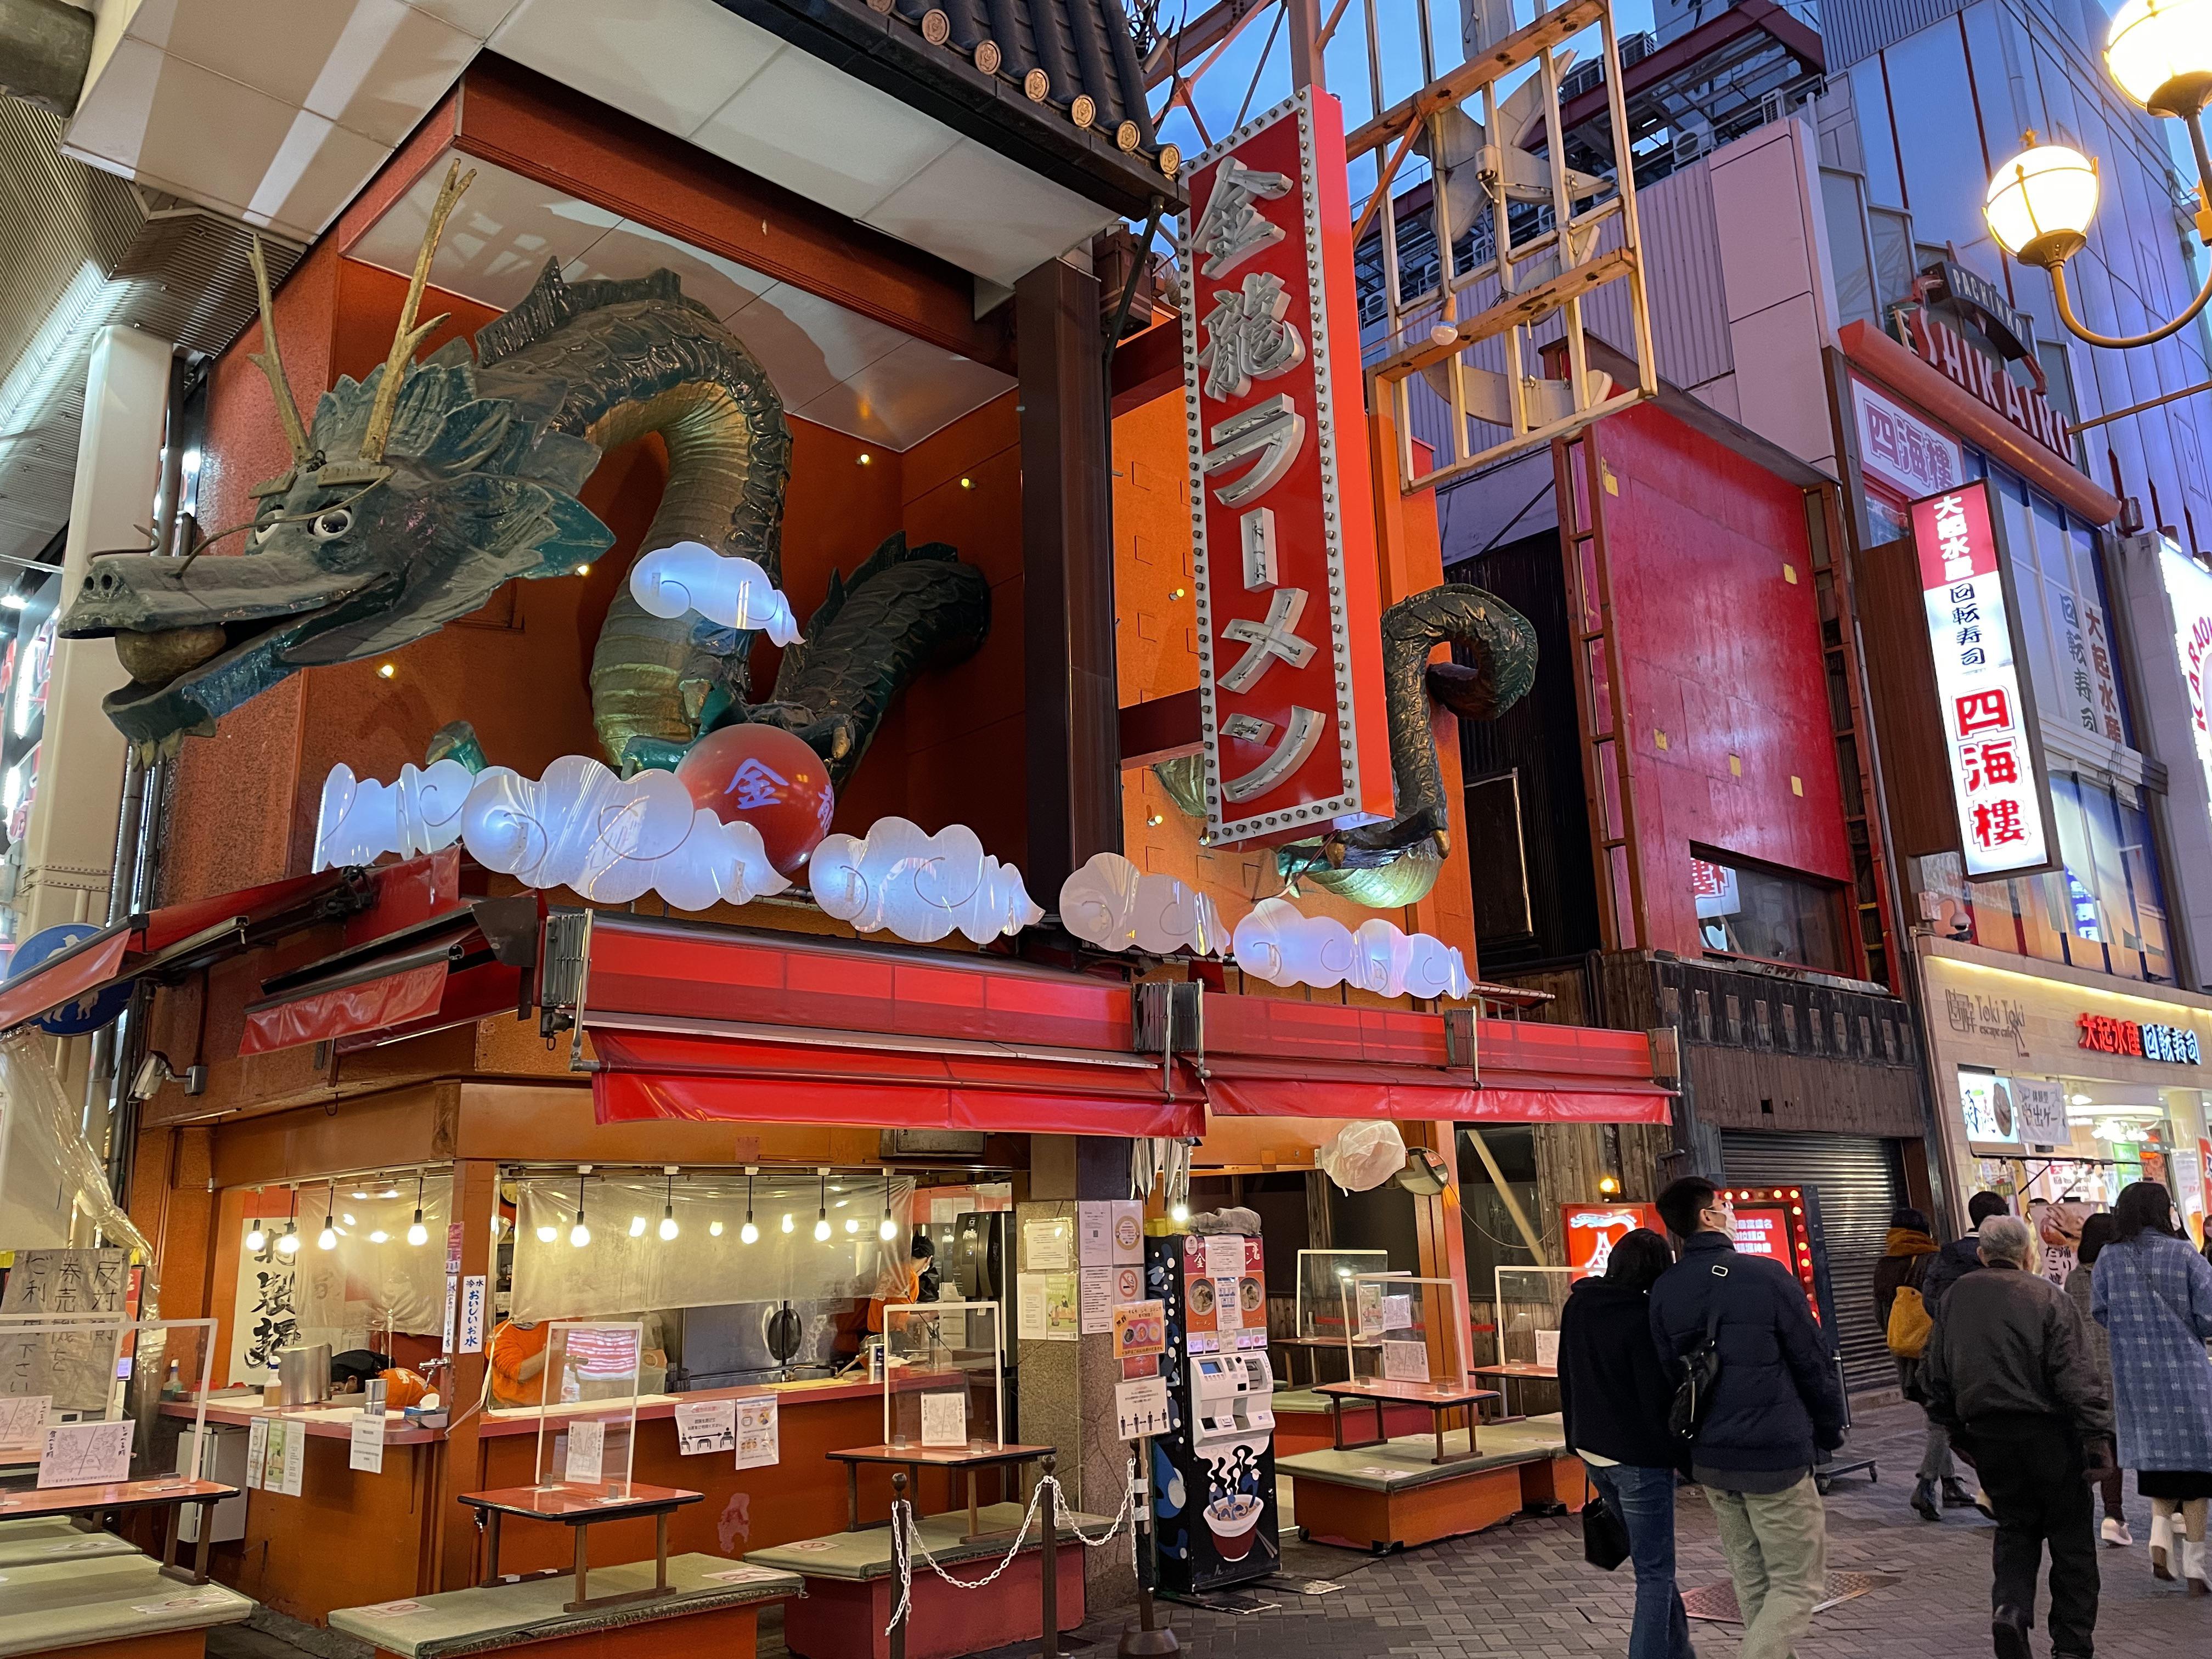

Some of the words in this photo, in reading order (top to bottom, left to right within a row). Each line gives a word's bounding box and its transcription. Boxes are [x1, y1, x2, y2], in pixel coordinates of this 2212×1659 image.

[1952, 268, 2024, 342] PACHINKO
[1912, 307, 2076, 466] SHIKAIRO
[1190, 156, 1326, 804] 金龍ラーメン
[1950, 583, 1986, 666] 回転寿司
[2059, 593, 2098, 734] 回転寿司
[2085, 607, 2121, 744] 大起水産
[724, 757, 789, 810] 金
[1954, 686, 2027, 849] 四海樓
[1974, 994, 2001, 1023] Toki
[2001, 999, 2025, 1027] Toki
[2077, 1013, 2142, 1057] 大起水産
[2142, 1023, 2202, 1065] 回転寿司
[464, 1290, 479, 1347] おいしいお水
[466, 1278, 484, 1288] 冷水
